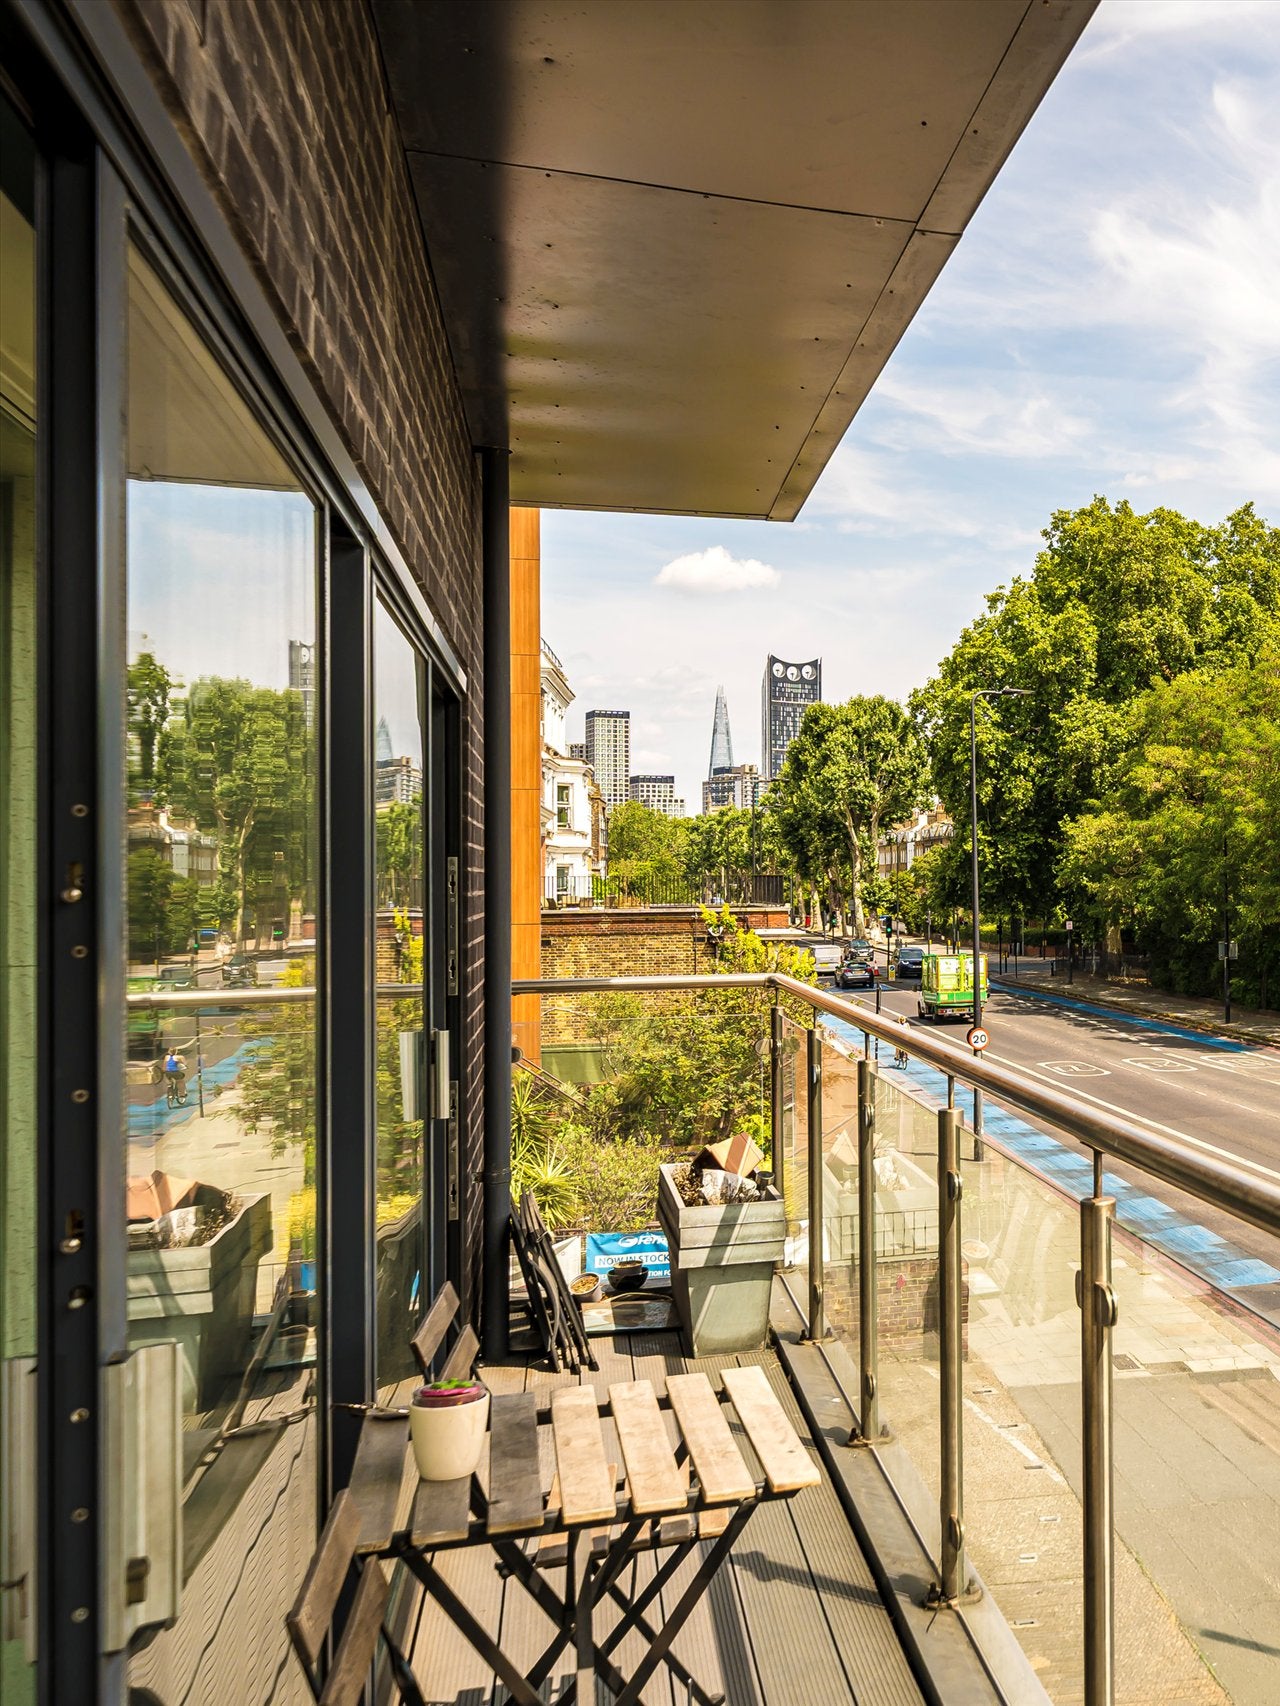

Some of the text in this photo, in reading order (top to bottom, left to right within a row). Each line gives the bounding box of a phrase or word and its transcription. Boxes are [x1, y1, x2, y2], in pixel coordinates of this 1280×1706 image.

[972, 1034, 986, 1044] 20
[598, 1256, 624, 1266] NOW
[638, 1253, 669, 1263] STOCK
